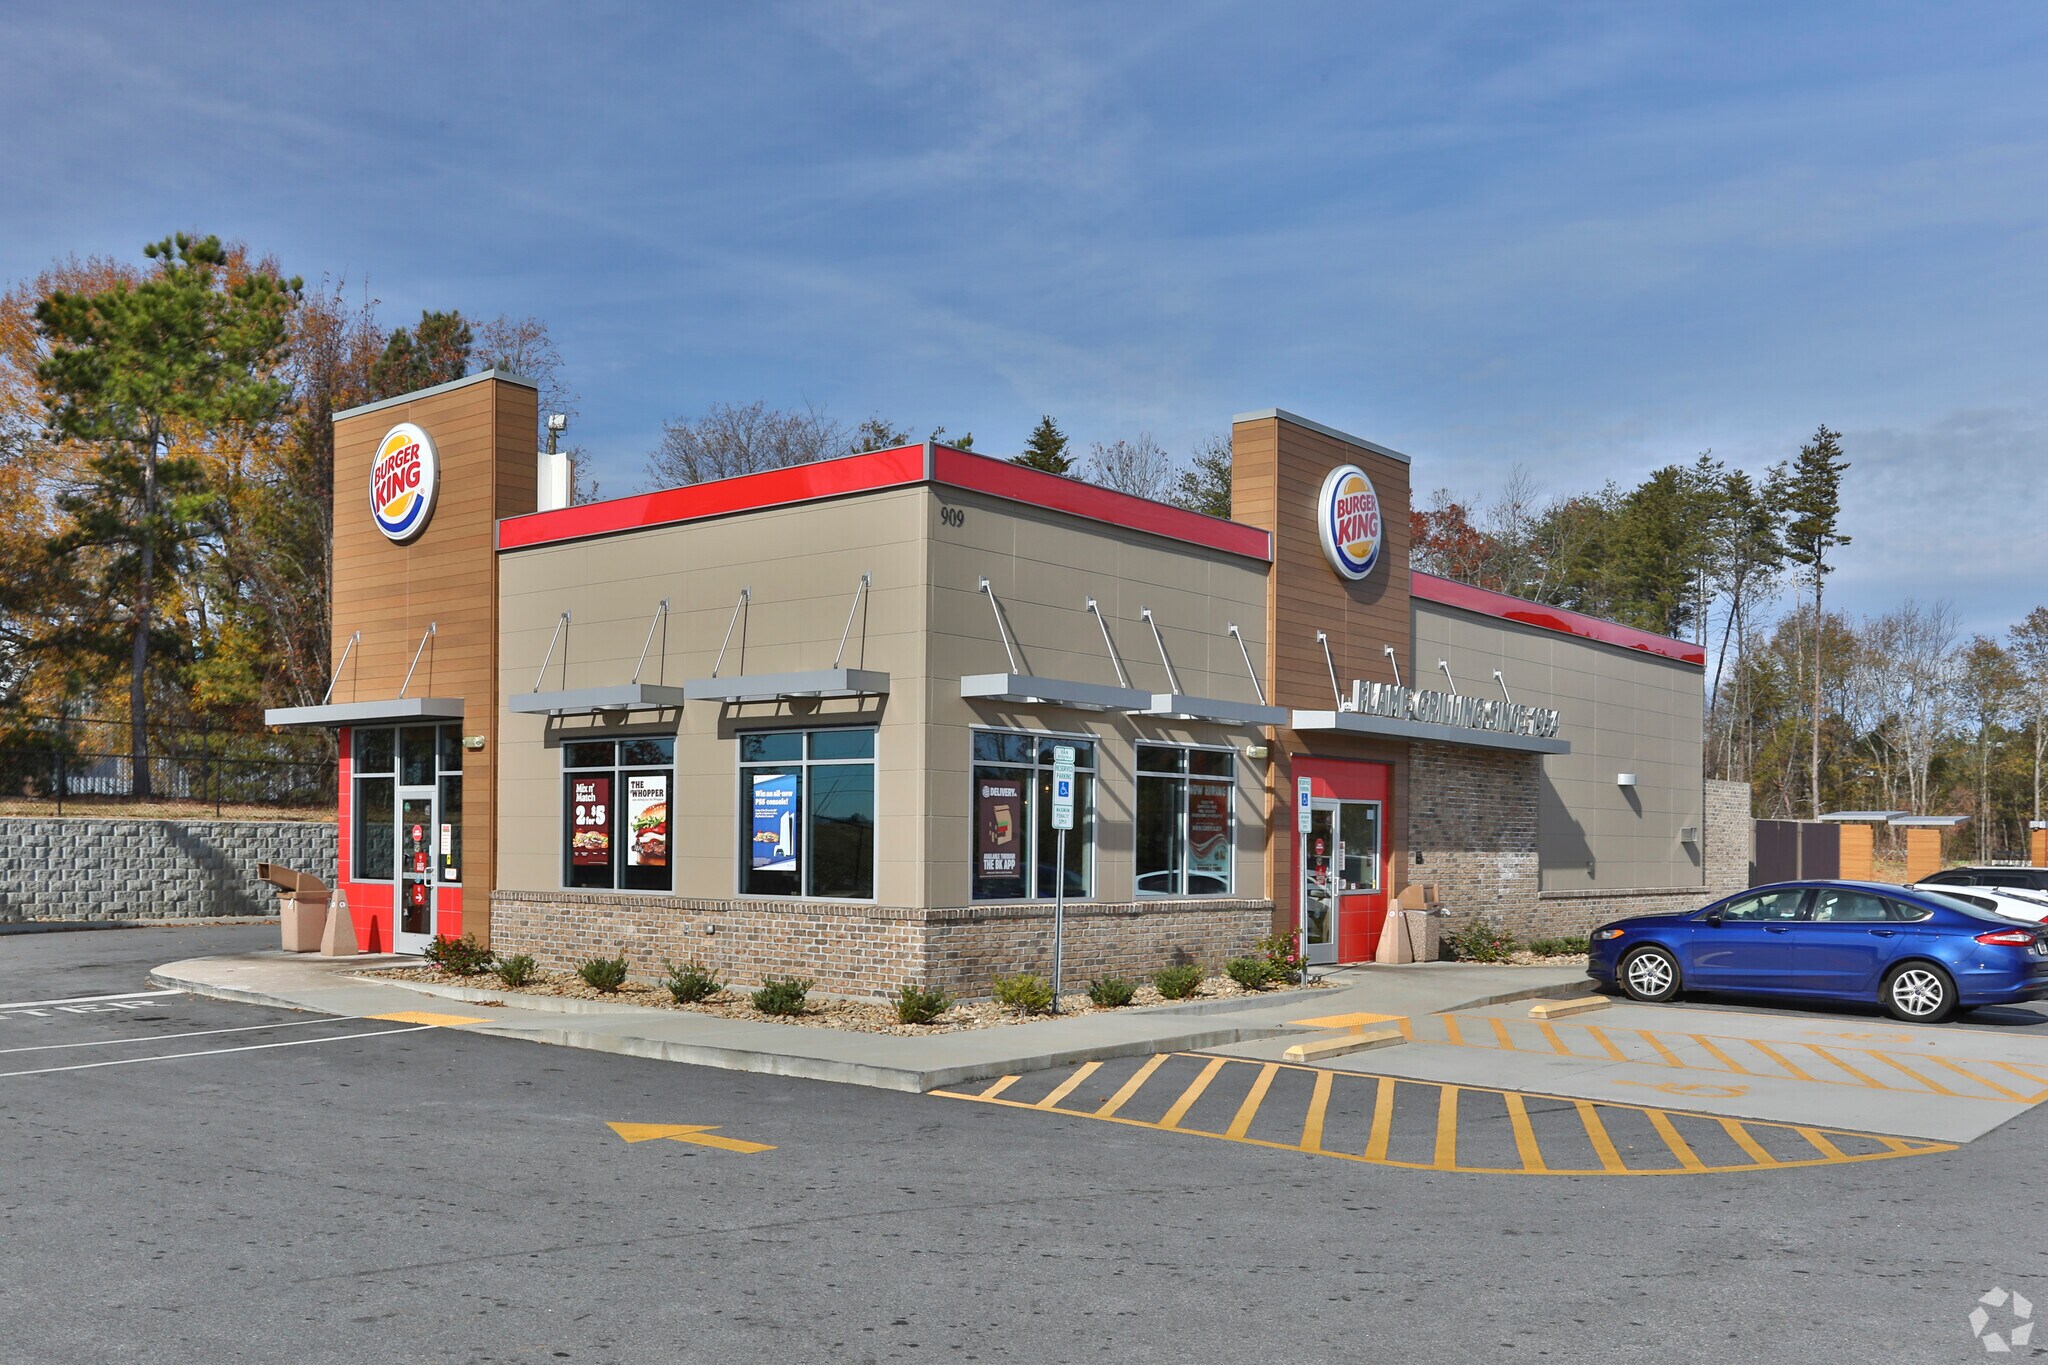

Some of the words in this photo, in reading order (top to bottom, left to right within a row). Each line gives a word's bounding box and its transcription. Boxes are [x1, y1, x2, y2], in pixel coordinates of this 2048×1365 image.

[375, 443, 420, 487] BURGER
[375, 461, 421, 513] KING
[1337, 494, 1376, 518] BURGER
[941, 506, 964, 528] 909
[1338, 512, 1378, 546] KING
[1352, 679, 1413, 720] FLAME
[1413, 689, 1485, 728] GRILLING
[1485, 700, 1527, 735] SINCE
[1527, 707, 1560, 738] 1954
[576, 784, 588, 792] Mix
[576, 793, 595, 802] Match
[630, 789, 664, 797] WHOPPER
[576, 805, 585, 825] 2
[586, 816, 595, 825] for
[591, 805, 605, 825] $5
[983, 859, 995, 870] THE
[995, 859, 1003, 870] BK
[1003, 859, 1016, 870] APP
[0, 1000, 171, 1020] TER
